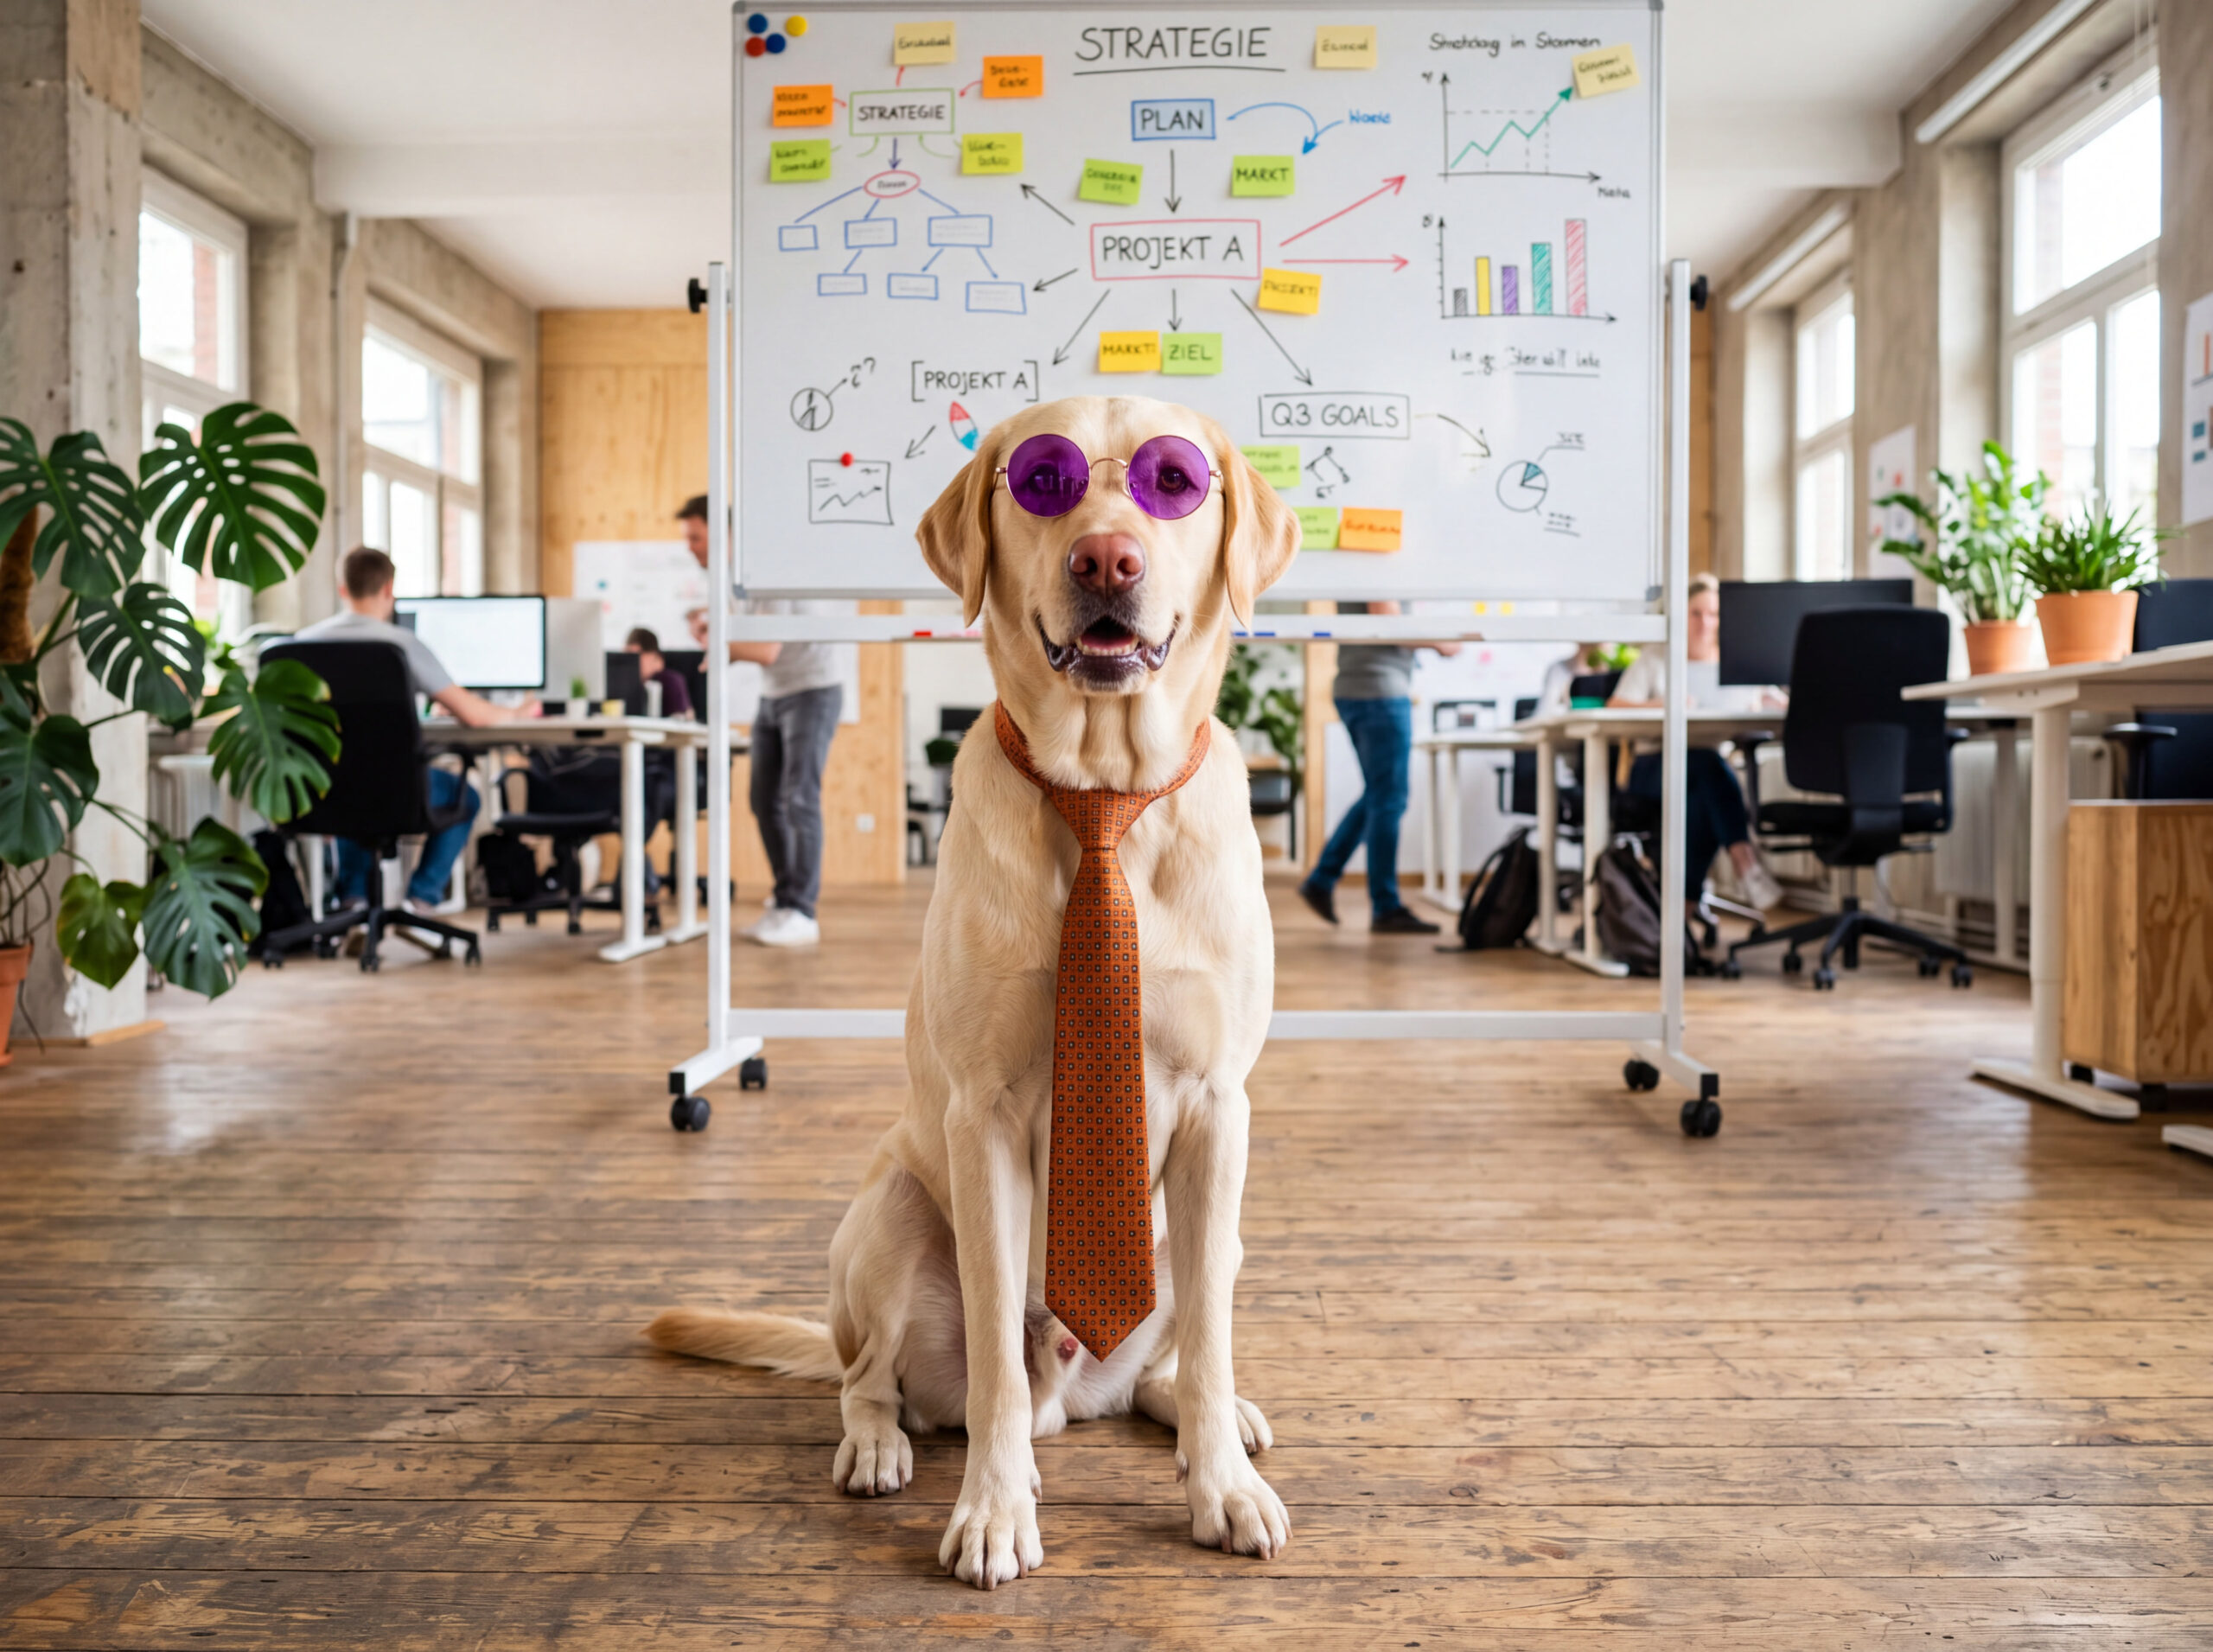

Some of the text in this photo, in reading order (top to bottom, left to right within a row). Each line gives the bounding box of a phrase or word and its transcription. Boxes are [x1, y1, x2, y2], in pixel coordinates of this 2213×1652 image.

[1075, 26, 1272, 61] STRATEGIE
[858, 104, 945, 122] STRATEGIE
[1140, 107, 1204, 132] PLAN
[1235, 167, 1289, 182] MARKT
[1102, 235, 1244, 270] PROJEKT A
[1168, 343, 1213, 361] ZIEL
[1012, 372, 1029, 389] A
[1271, 401, 1399, 429] Q3 GOALS
